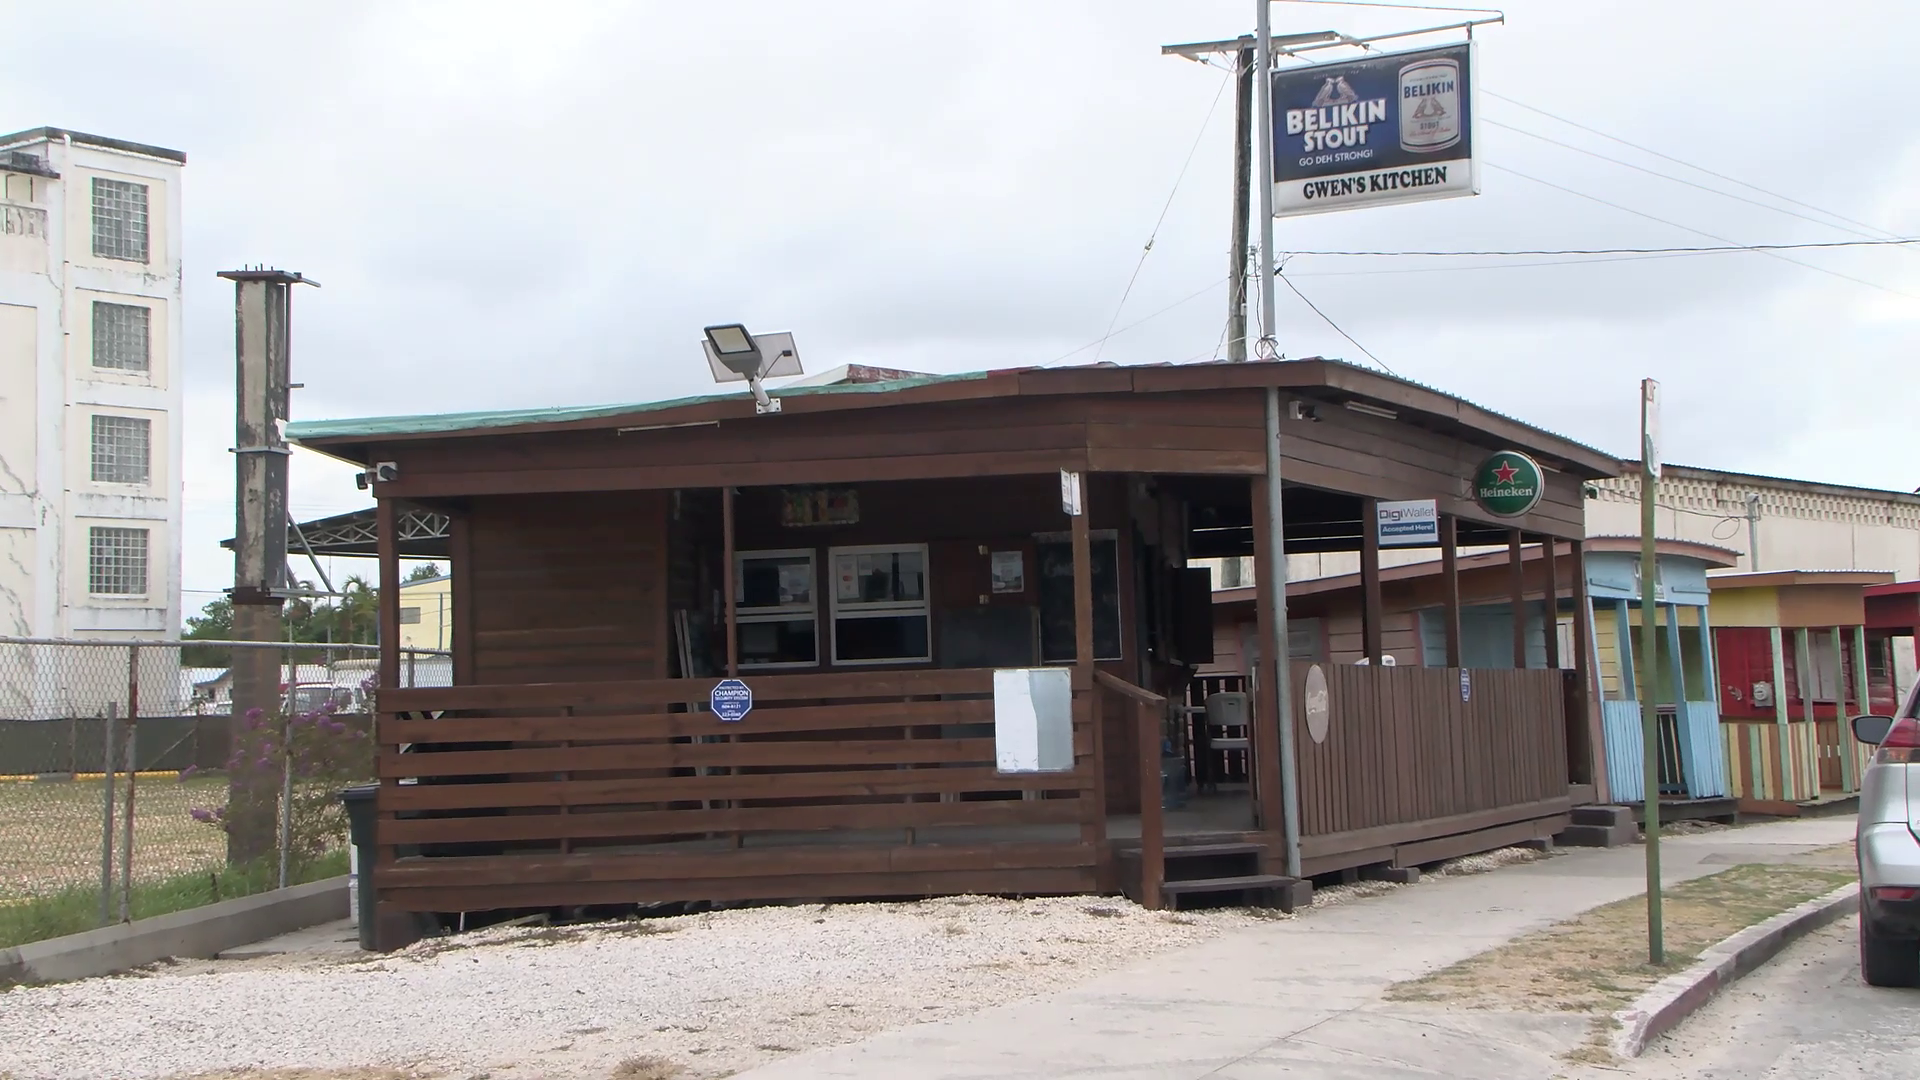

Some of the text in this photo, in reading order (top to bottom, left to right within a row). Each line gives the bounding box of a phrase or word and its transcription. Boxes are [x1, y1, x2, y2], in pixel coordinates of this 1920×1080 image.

[1403, 80, 1455, 99] BELIKIN
[1286, 99, 1386, 135] BELIKIN
[1303, 124, 1369, 153] STOUT
[1298, 149, 1374, 167] GO DEH STRONG!
[1303, 166, 1448, 200] GWEN'S KITCHEN
[1480, 486, 1534, 499] Heineken
[1379, 508, 1435, 522] DigiWallet
[1382, 523, 1434, 533] Accepted Here!
